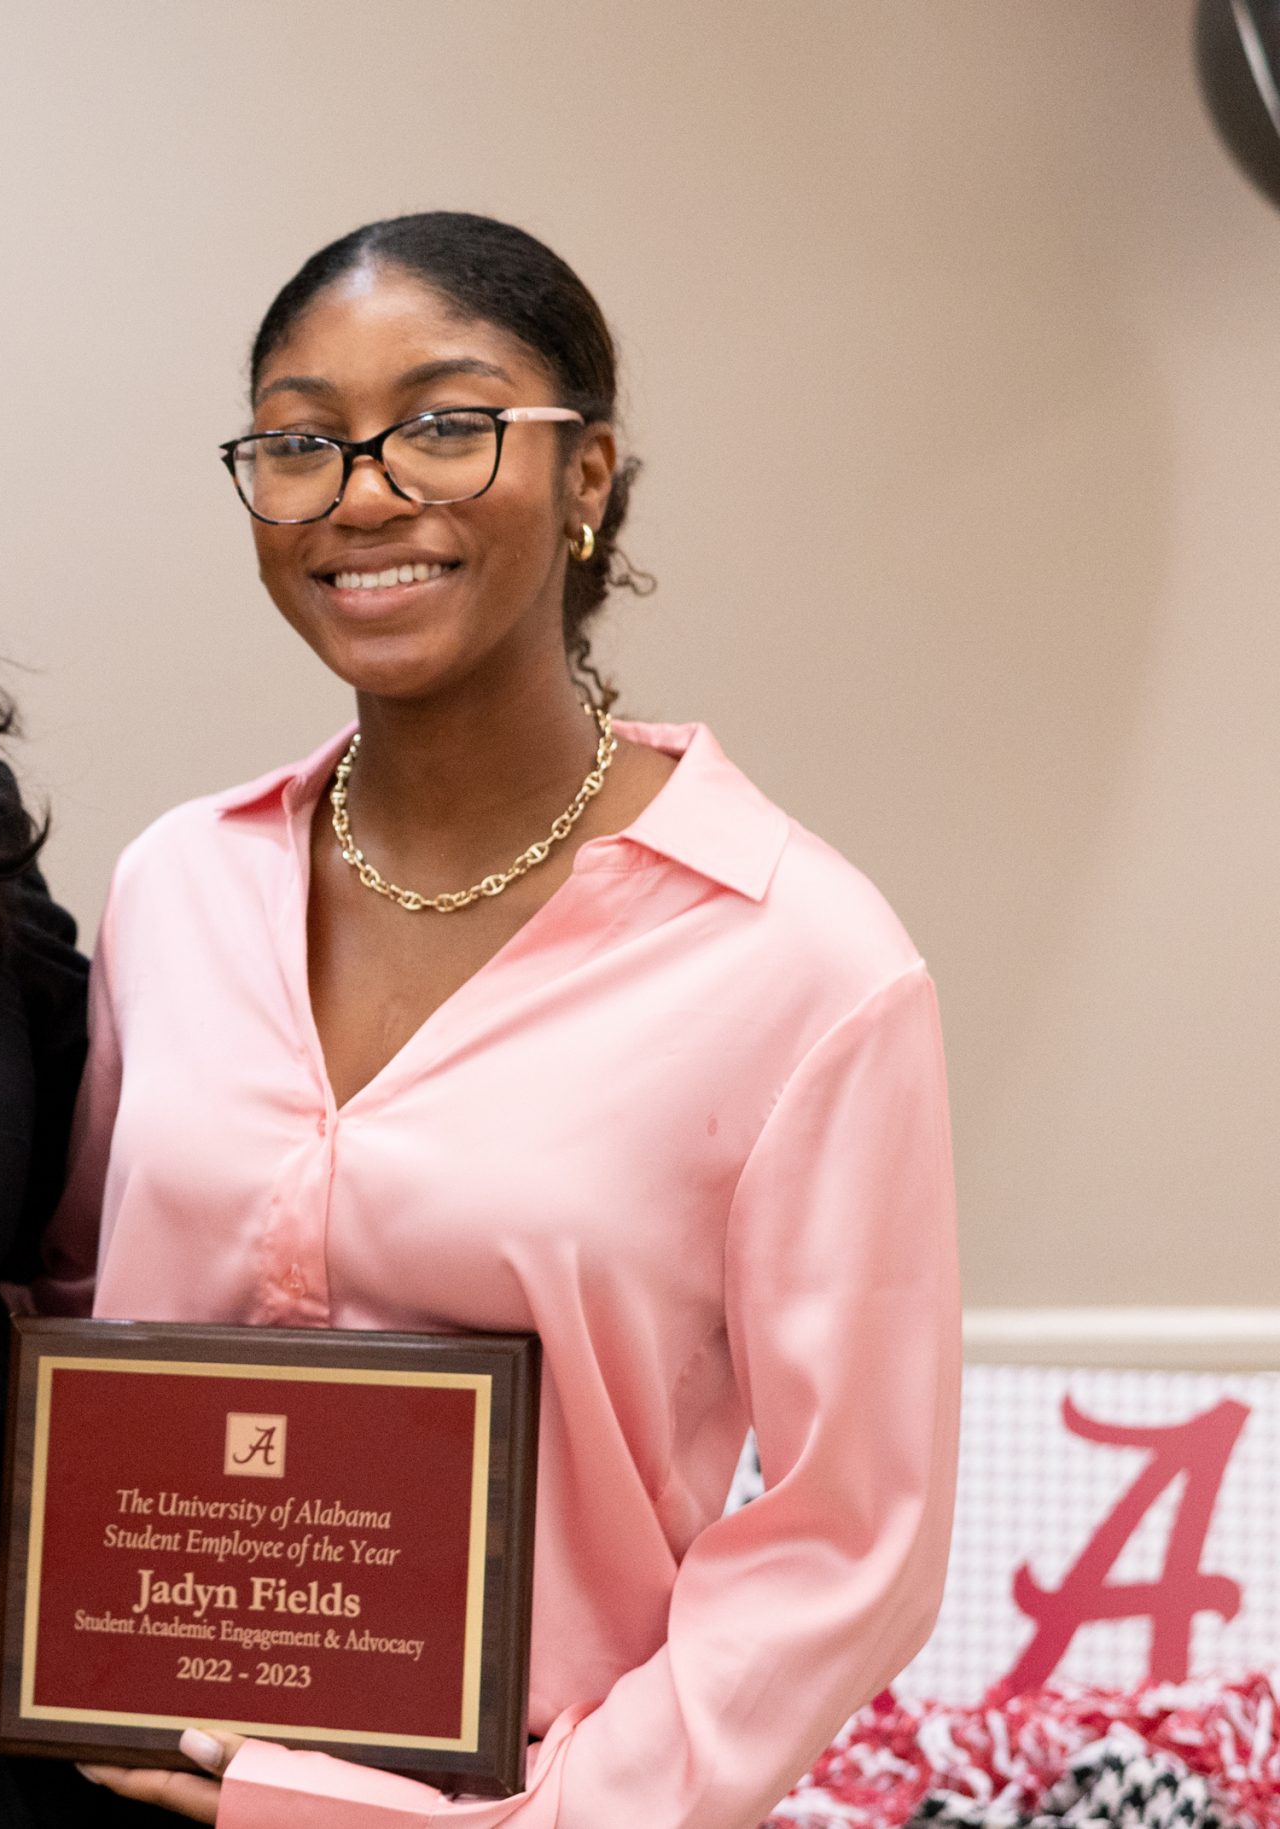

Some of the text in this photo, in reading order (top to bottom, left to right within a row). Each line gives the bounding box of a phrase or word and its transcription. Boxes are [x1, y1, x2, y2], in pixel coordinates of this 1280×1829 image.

[116, 1489, 392, 1530] The University of Alabama
[103, 1524, 401, 1567] Student Employee of the Year
[996, 1392, 1251, 1698] A
[132, 1569, 362, 1618] Jadyn Fields
[74, 1609, 425, 1661] Student Academic Engagement & Advocacy
[176, 1656, 232, 1683] 2022
[255, 1662, 312, 1689] 2023
